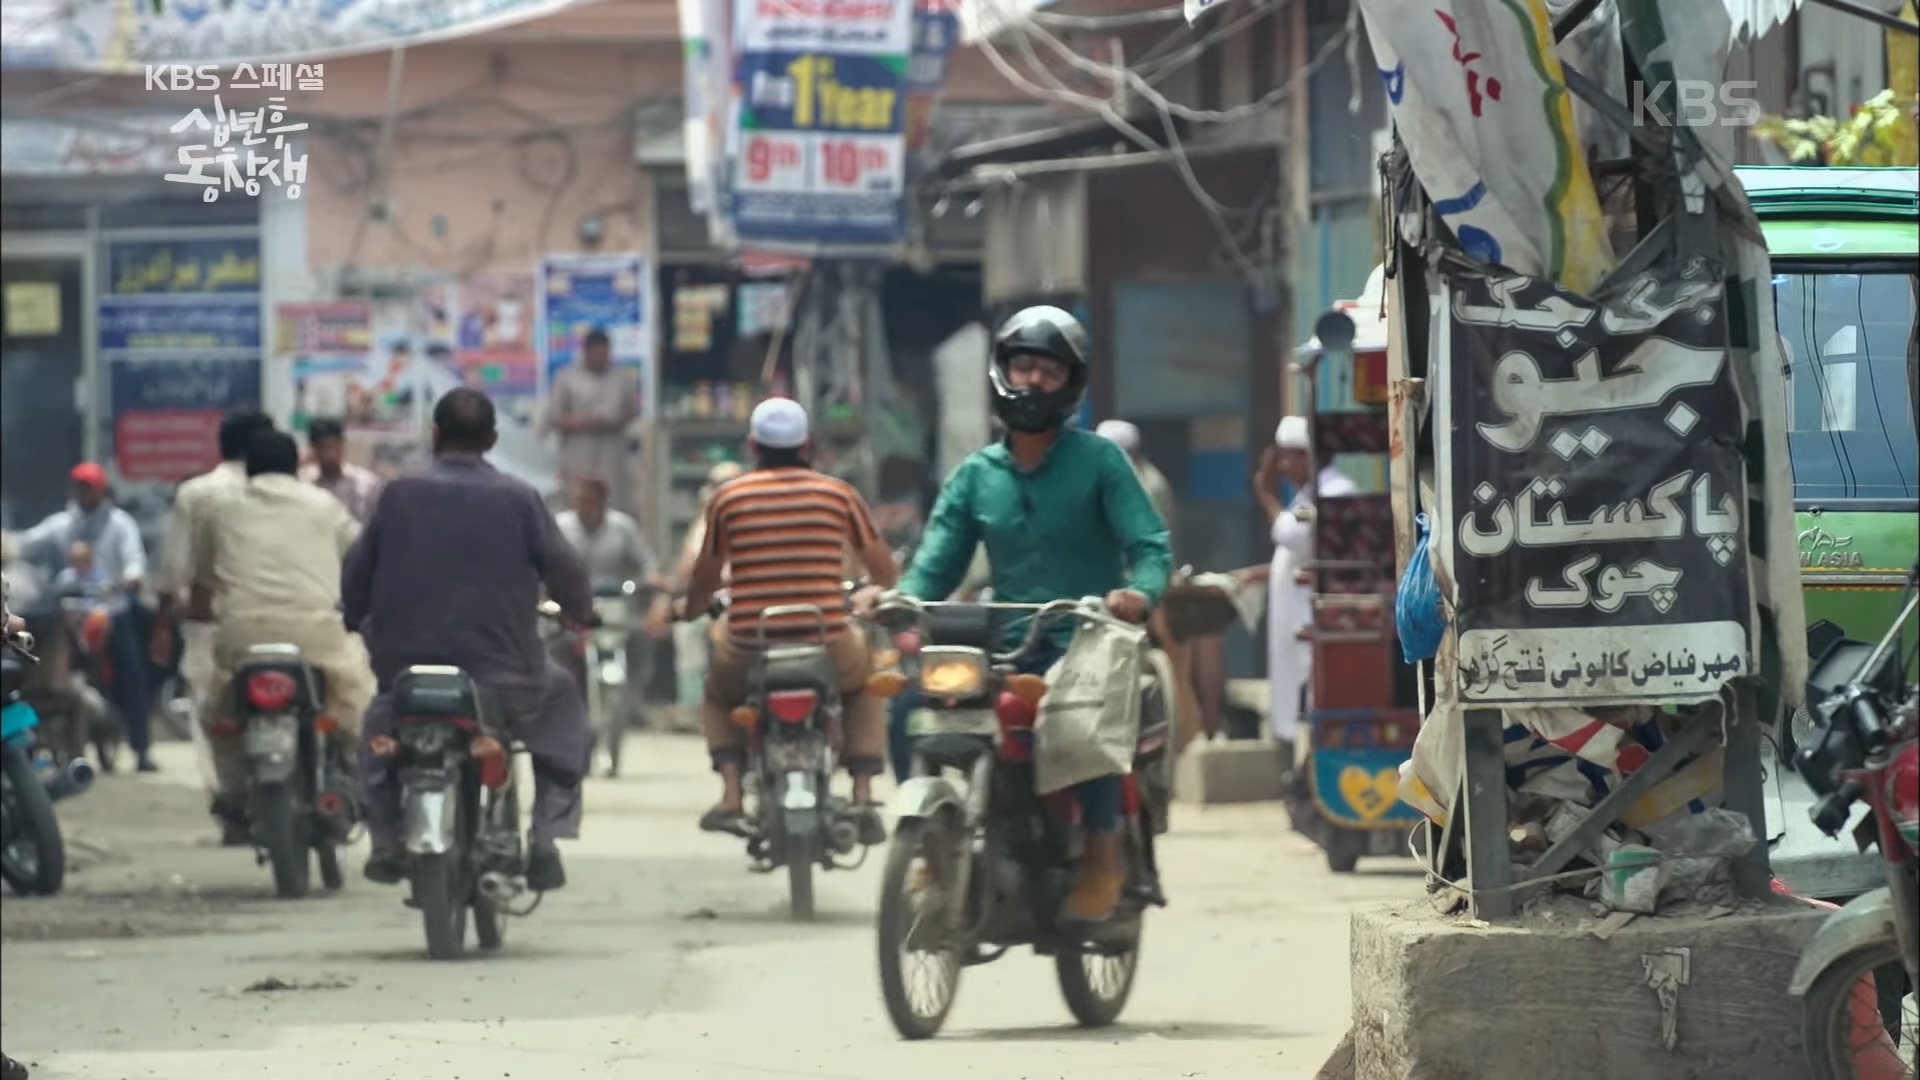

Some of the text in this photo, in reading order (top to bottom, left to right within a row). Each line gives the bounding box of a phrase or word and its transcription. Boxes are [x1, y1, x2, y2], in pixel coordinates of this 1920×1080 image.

[819, 78, 896, 130] Year
[1459, 470, 1741, 566] پاکستان
[1816, 551, 1863, 567] ASIA
[1525, 554, 1683, 614] چوک
[1503, 648, 1546, 691] فتح
[1550, 649, 1631, 689] کالونی
